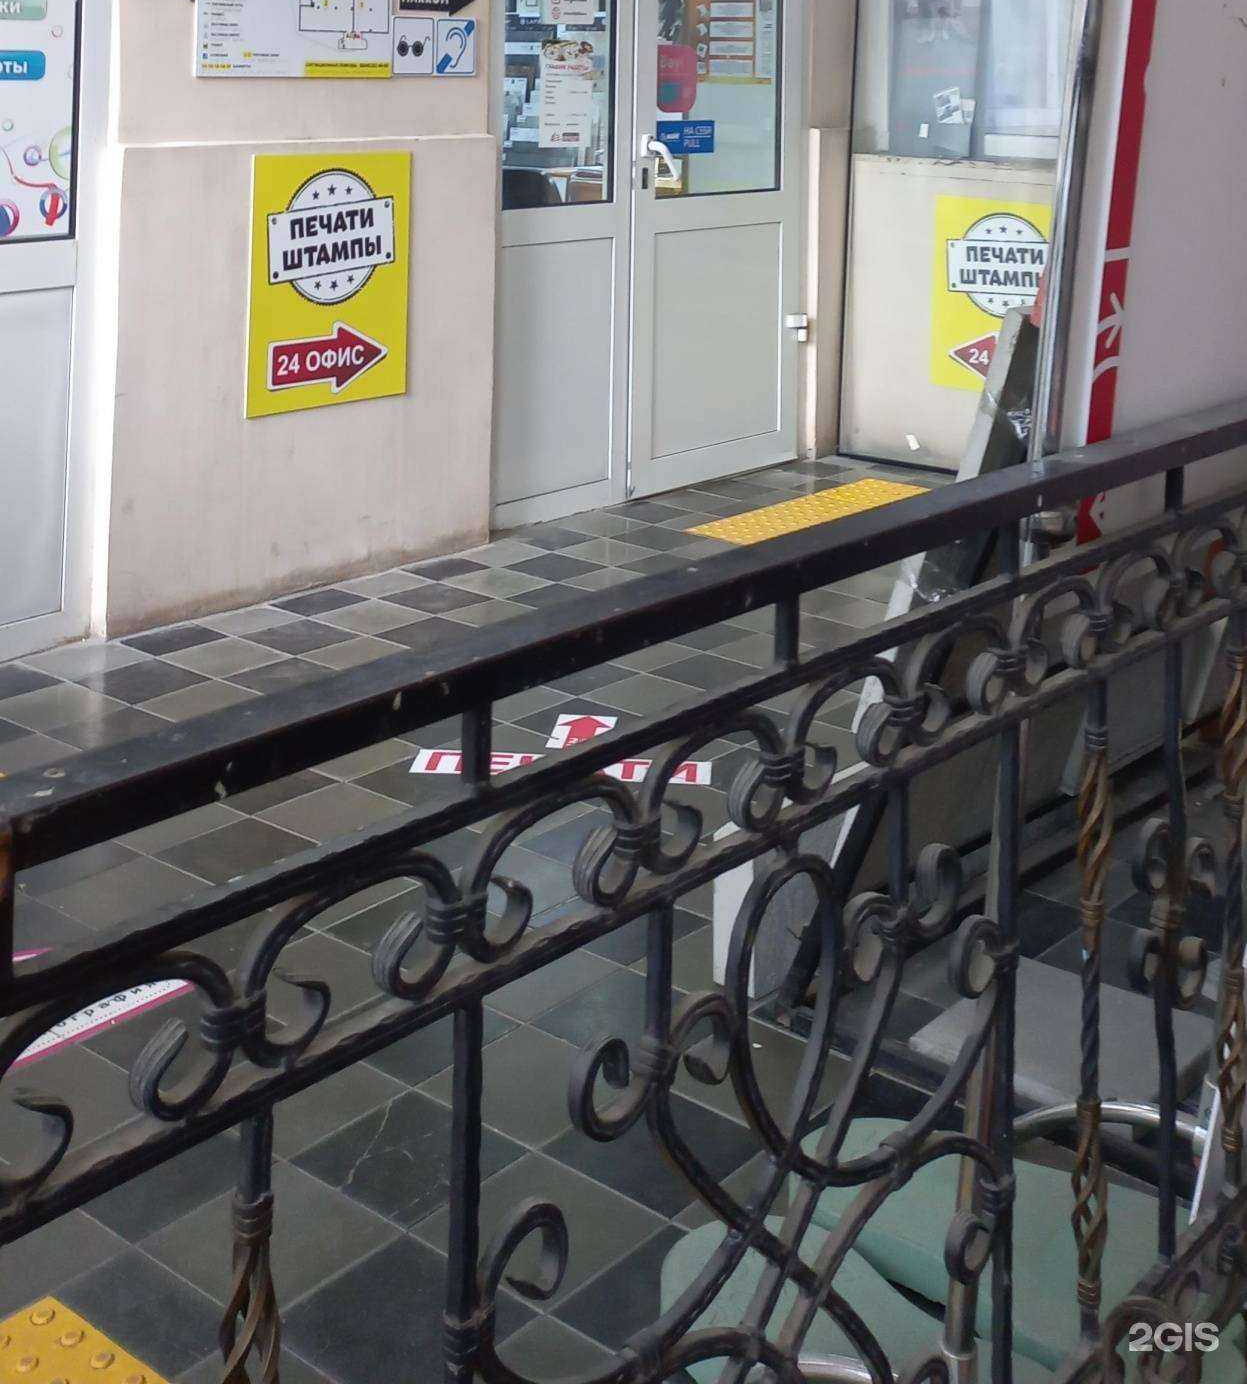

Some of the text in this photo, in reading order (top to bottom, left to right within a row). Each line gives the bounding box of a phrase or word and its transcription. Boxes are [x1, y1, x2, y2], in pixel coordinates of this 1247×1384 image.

[290, 208, 374, 240] ПЕЧАТИ
[283, 235, 382, 271] ШТАМПЫ
[966, 245, 1044, 265] ПЕЧАТИ
[277, 344, 365, 376] 24 ОФИС
[968, 348, 990, 365] 24
